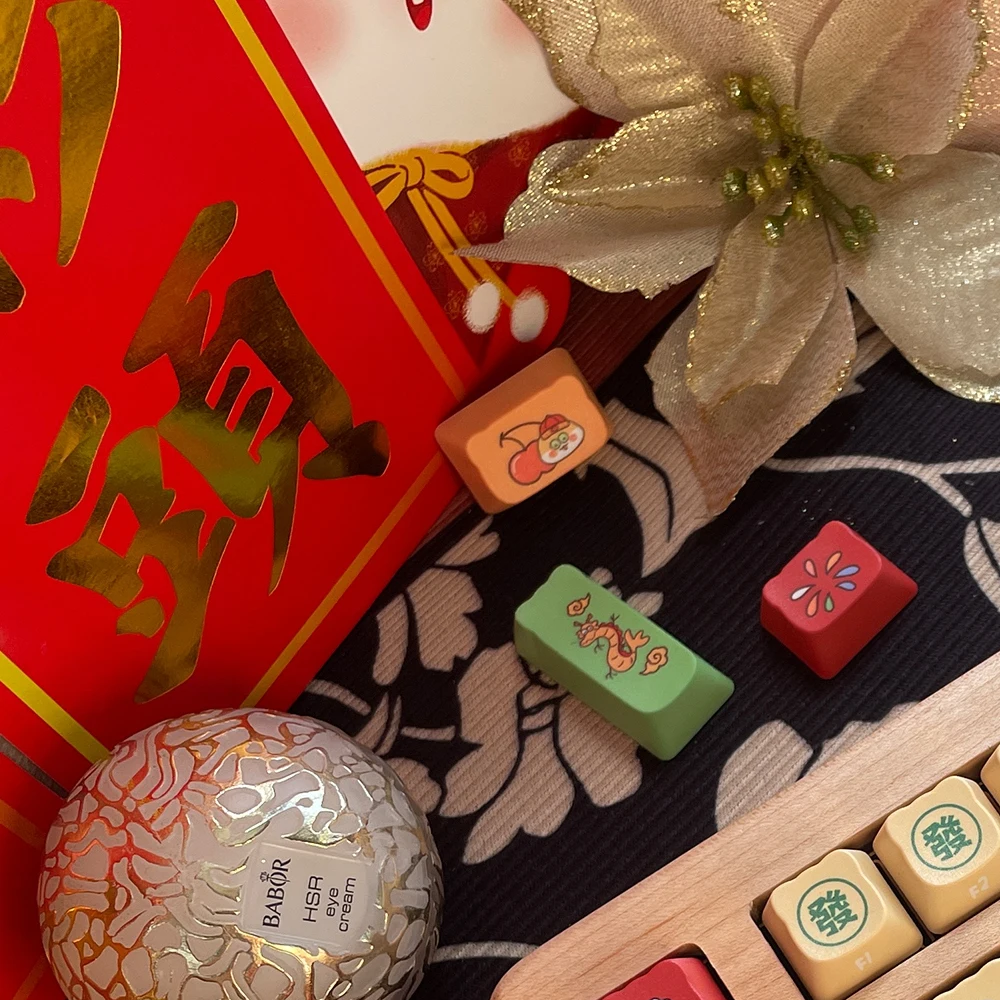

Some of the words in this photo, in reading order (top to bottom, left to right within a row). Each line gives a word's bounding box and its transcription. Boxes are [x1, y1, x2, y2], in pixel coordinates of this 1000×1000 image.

[920, 814, 973, 862] 發
[261, 858, 292, 928] BABOR
[303, 875, 324, 923] HSR
[326, 887, 340, 917] eye
[339, 877, 357, 932] cream
[968, 876, 989, 899] F2
[807, 889, 859, 937] 發
[854, 951, 873, 971] F1
